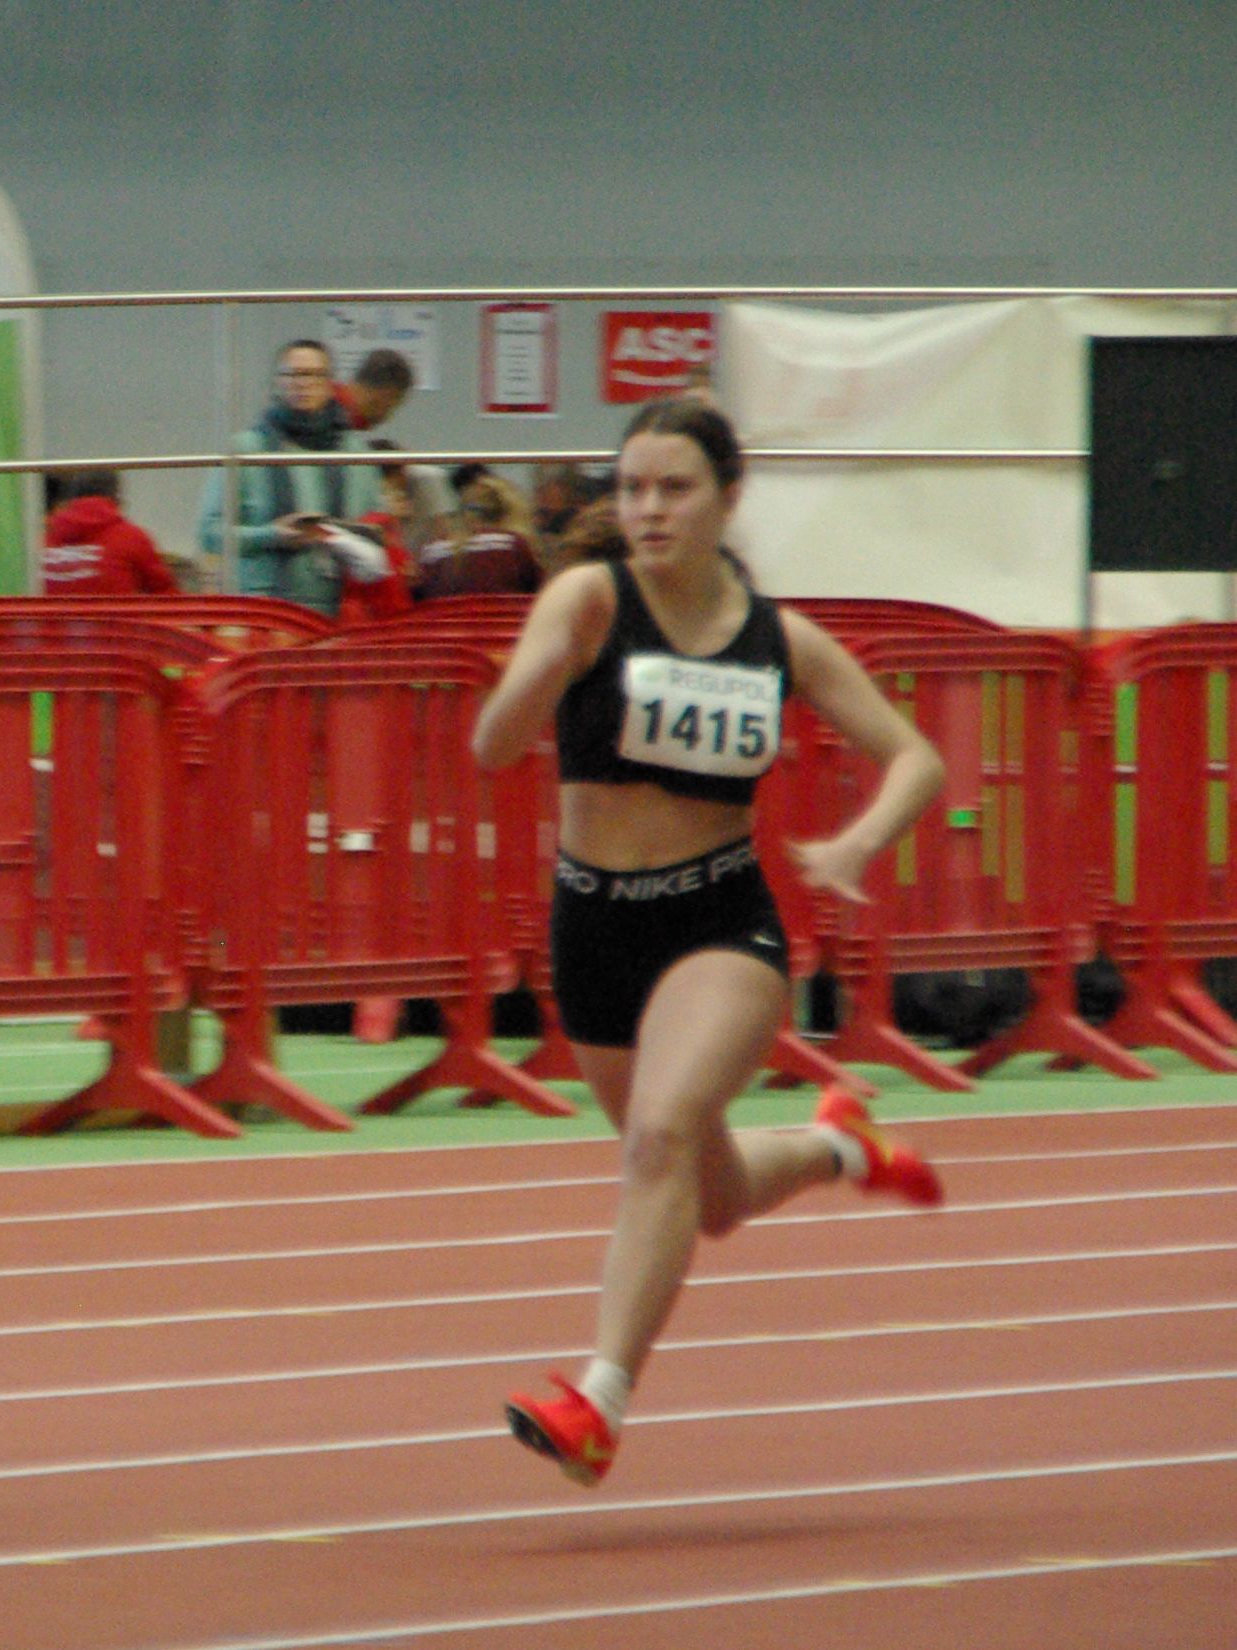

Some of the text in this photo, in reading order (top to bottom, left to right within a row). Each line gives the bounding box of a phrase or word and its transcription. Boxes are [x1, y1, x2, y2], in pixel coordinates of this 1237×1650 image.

[611, 326, 717, 363] ASC
[642, 698, 767, 759] 1415
[610, 864, 706, 901] NIKE
